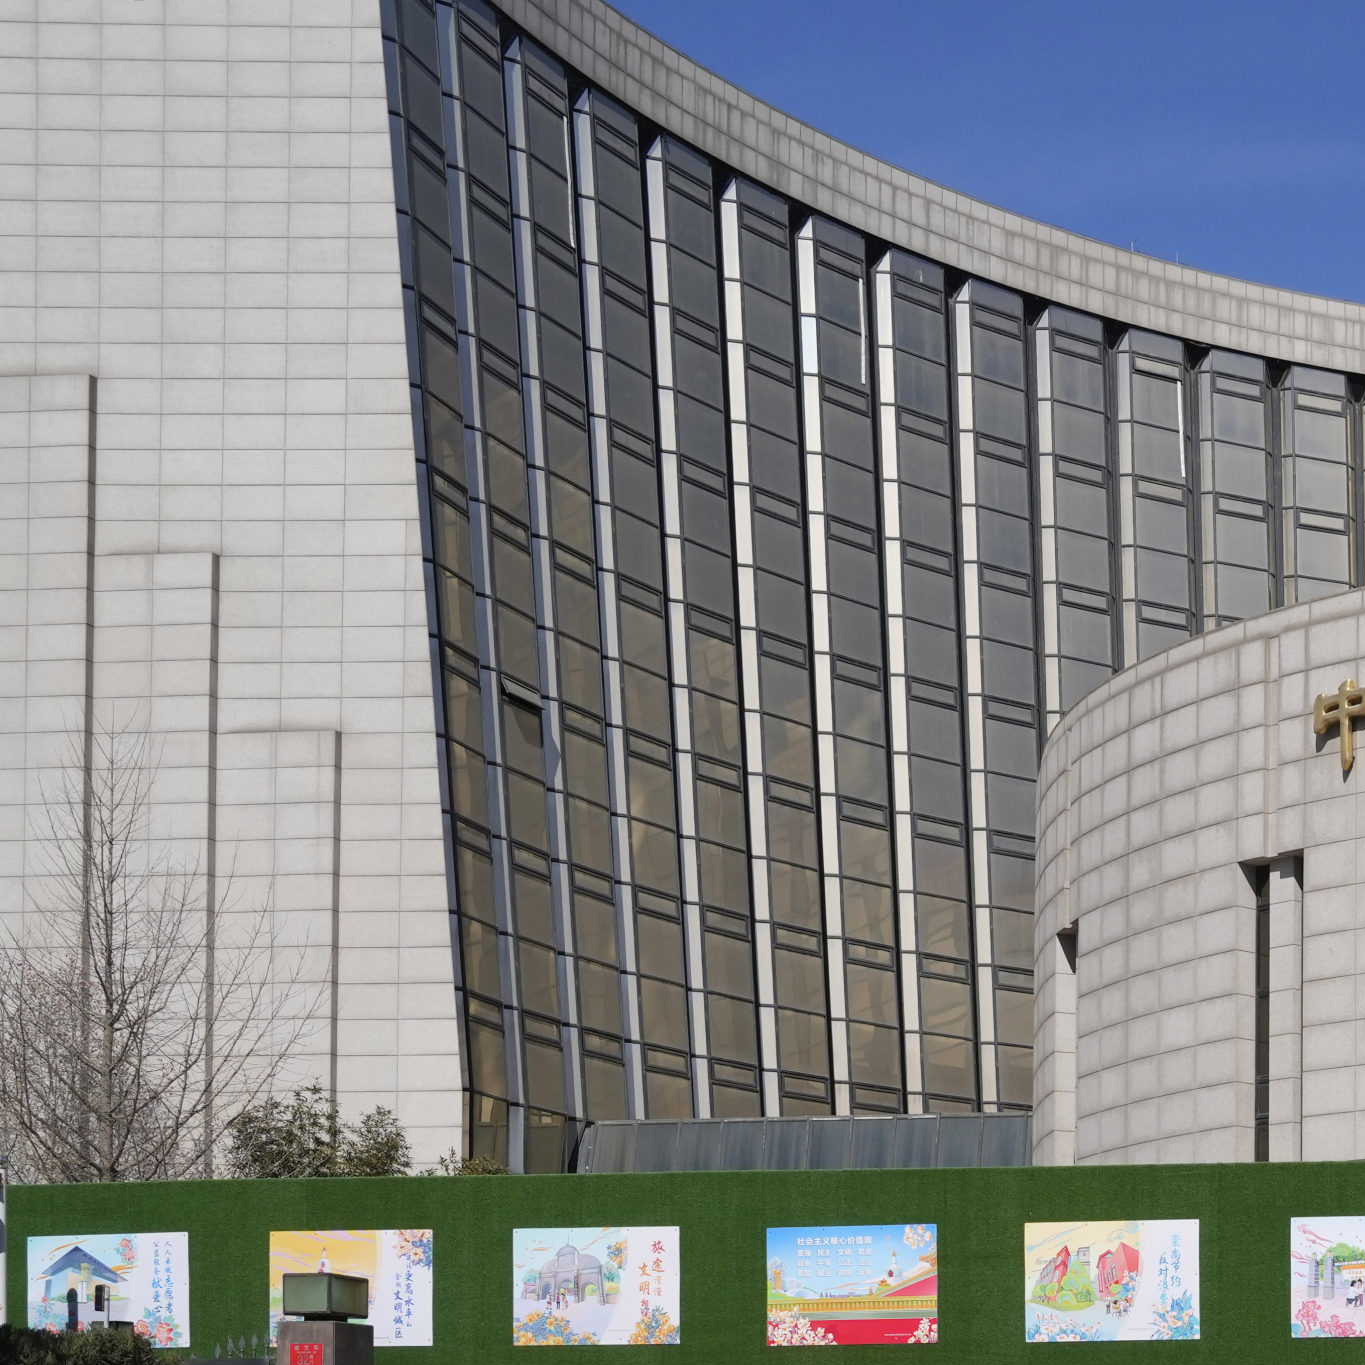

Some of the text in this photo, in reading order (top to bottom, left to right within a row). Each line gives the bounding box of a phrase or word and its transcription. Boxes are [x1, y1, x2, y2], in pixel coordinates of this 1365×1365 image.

[796, 1236, 873, 1246] 社会主义核心价值观
